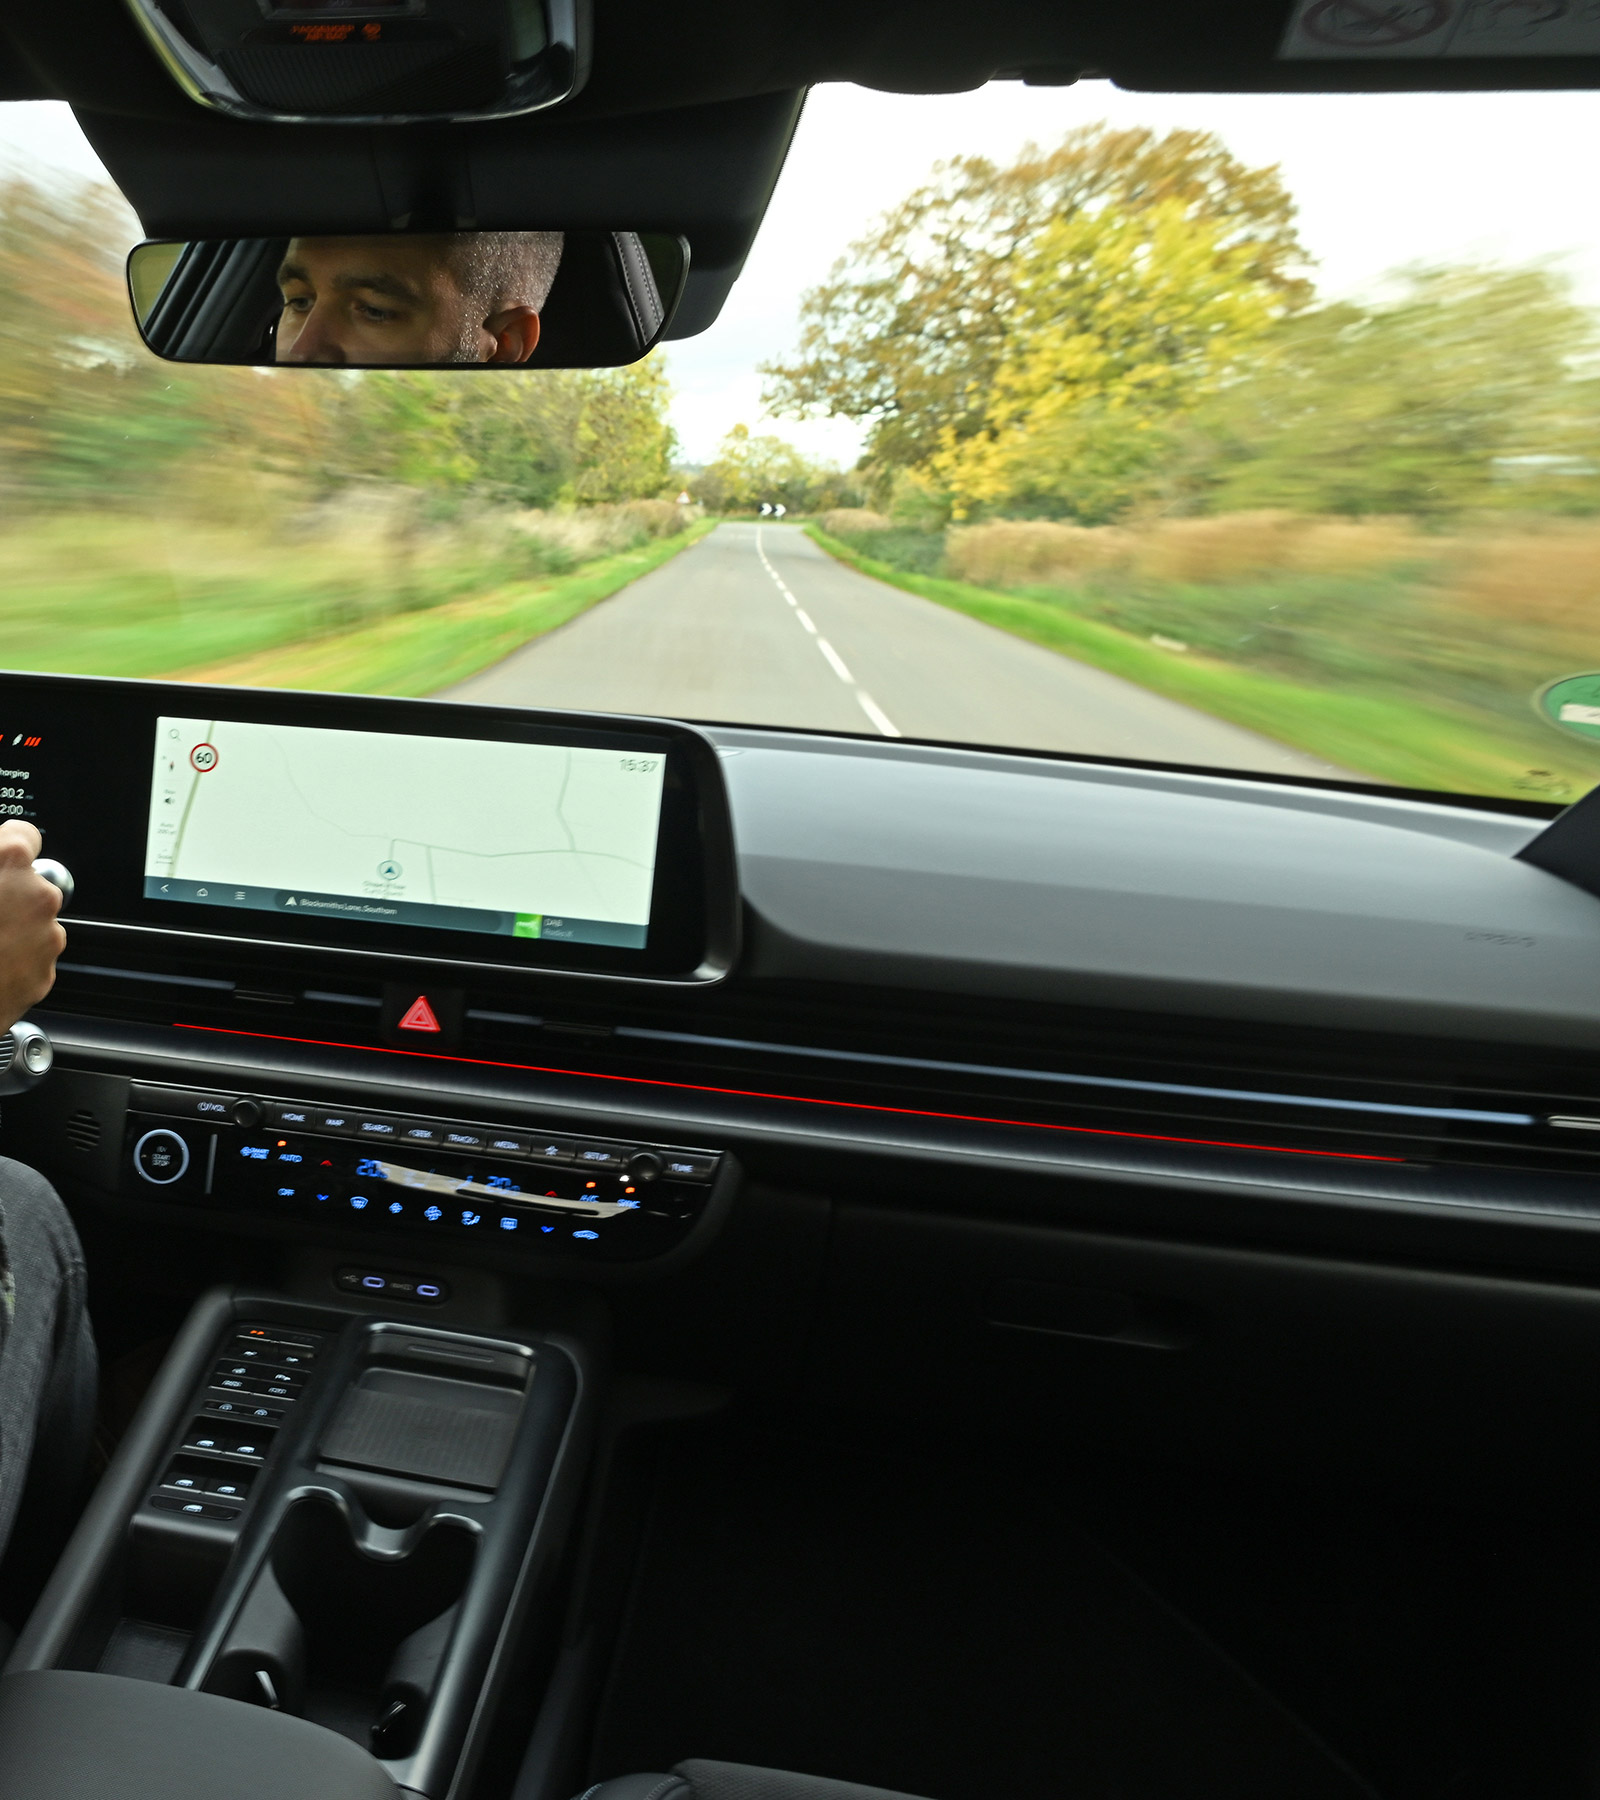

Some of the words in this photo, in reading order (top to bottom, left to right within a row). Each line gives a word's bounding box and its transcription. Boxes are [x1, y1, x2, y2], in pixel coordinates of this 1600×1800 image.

[196, 752, 213, 764] 60
[619, 758, 659, 773] 15:37
[0, 787, 25, 799] 30.2
[281, 1113, 306, 1123] HOME
[325, 1118, 345, 1127] MAP
[361, 1122, 394, 1134] SEARCH
[151, 1153, 172, 1161] START
[278, 1153, 303, 1163] AUTO
[583, 1151, 611, 1161] SETUP
[151, 1160, 171, 1168] STOP
[277, 1187, 295, 1197] OFF
